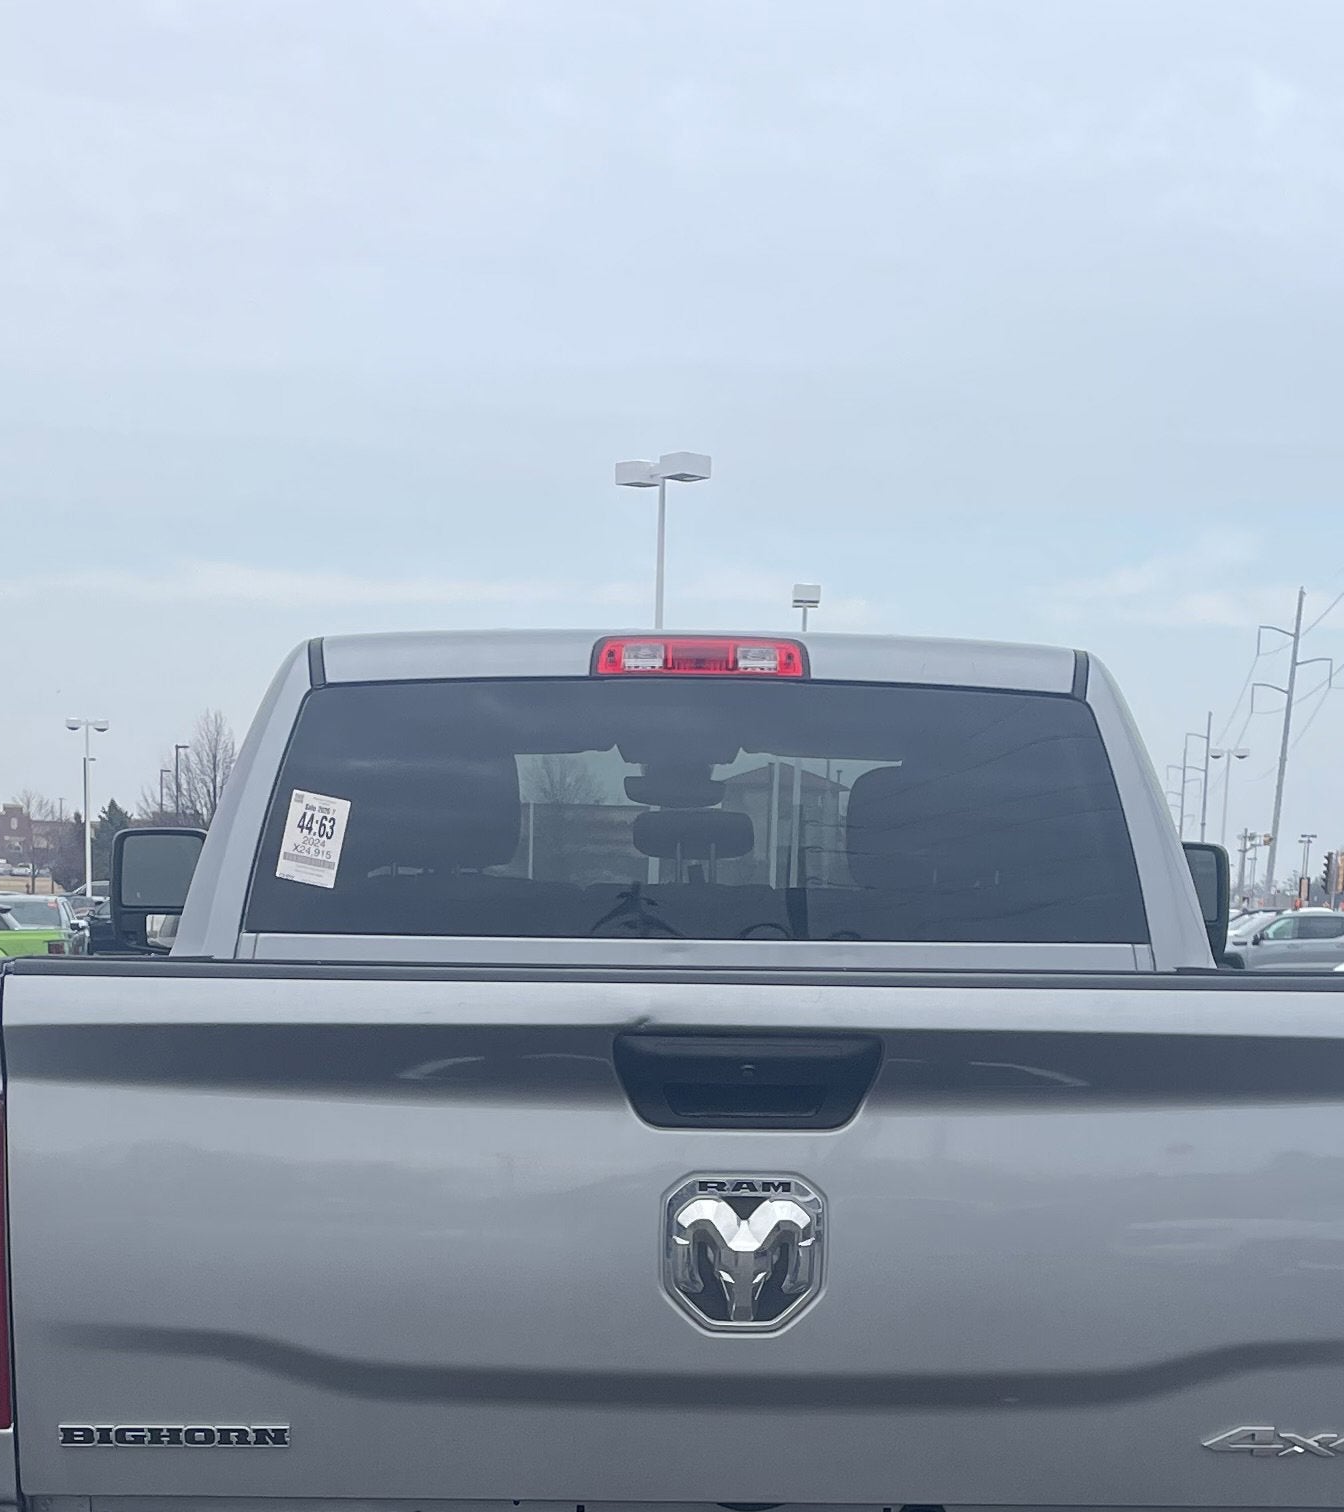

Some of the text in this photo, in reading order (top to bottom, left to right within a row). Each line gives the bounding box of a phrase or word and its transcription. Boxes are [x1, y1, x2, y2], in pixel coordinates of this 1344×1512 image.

[297, 811, 336, 840] 44:63
[301, 836, 326, 848] 2024
[698, 1180, 791, 1193] RAM
[58, 1424, 290, 1447] BIGHORN
